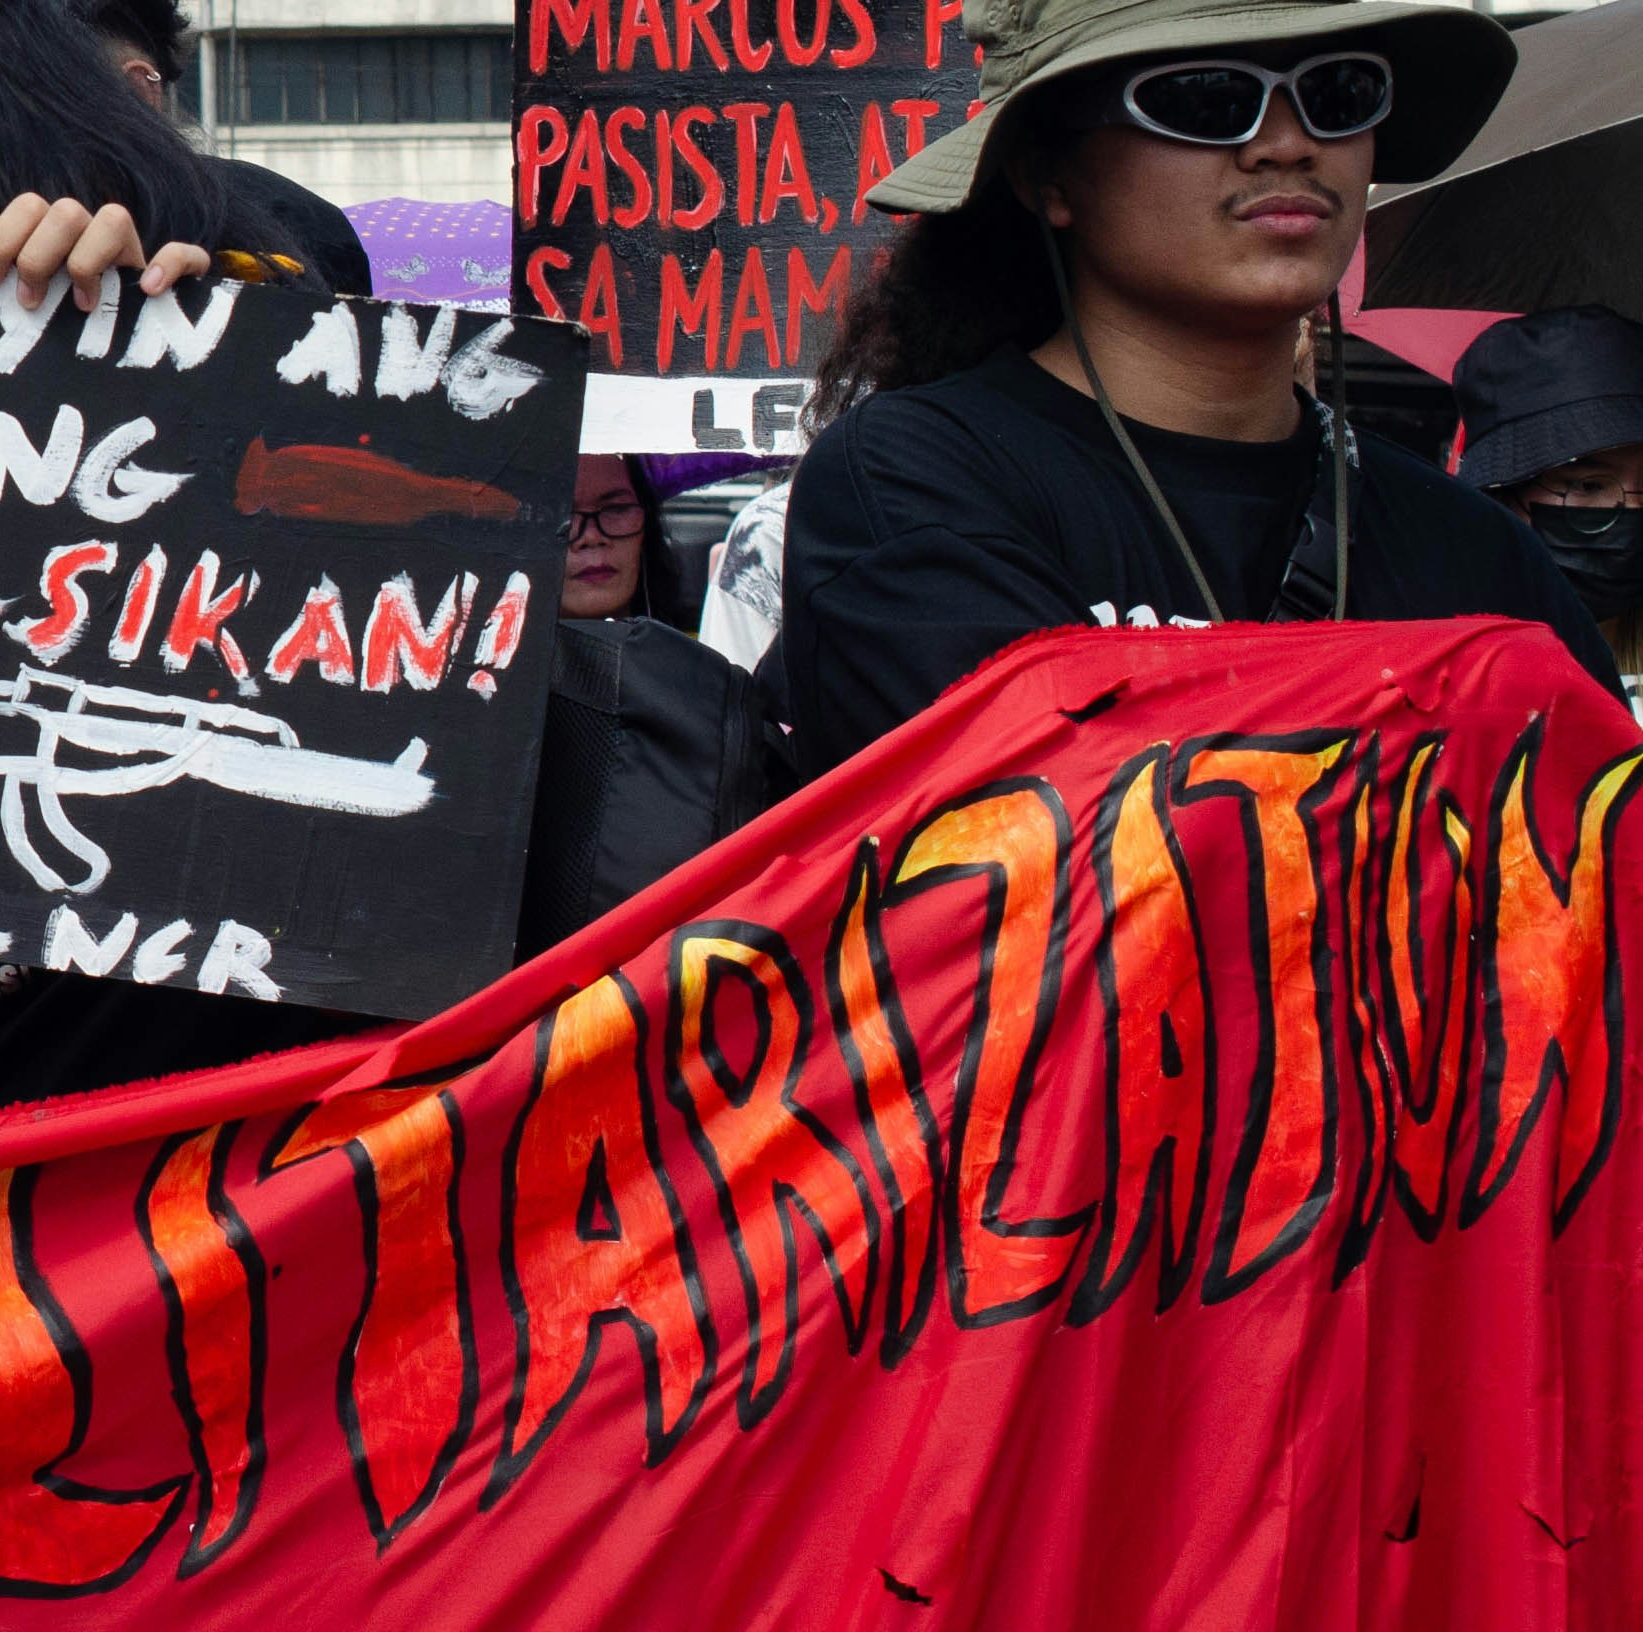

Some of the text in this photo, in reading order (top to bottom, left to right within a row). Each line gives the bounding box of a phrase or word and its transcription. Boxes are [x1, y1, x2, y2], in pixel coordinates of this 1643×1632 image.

[517, 101, 840, 233] PASISTA,
[276, 301, 550, 420] ANG
[526, 243, 624, 370] SA
